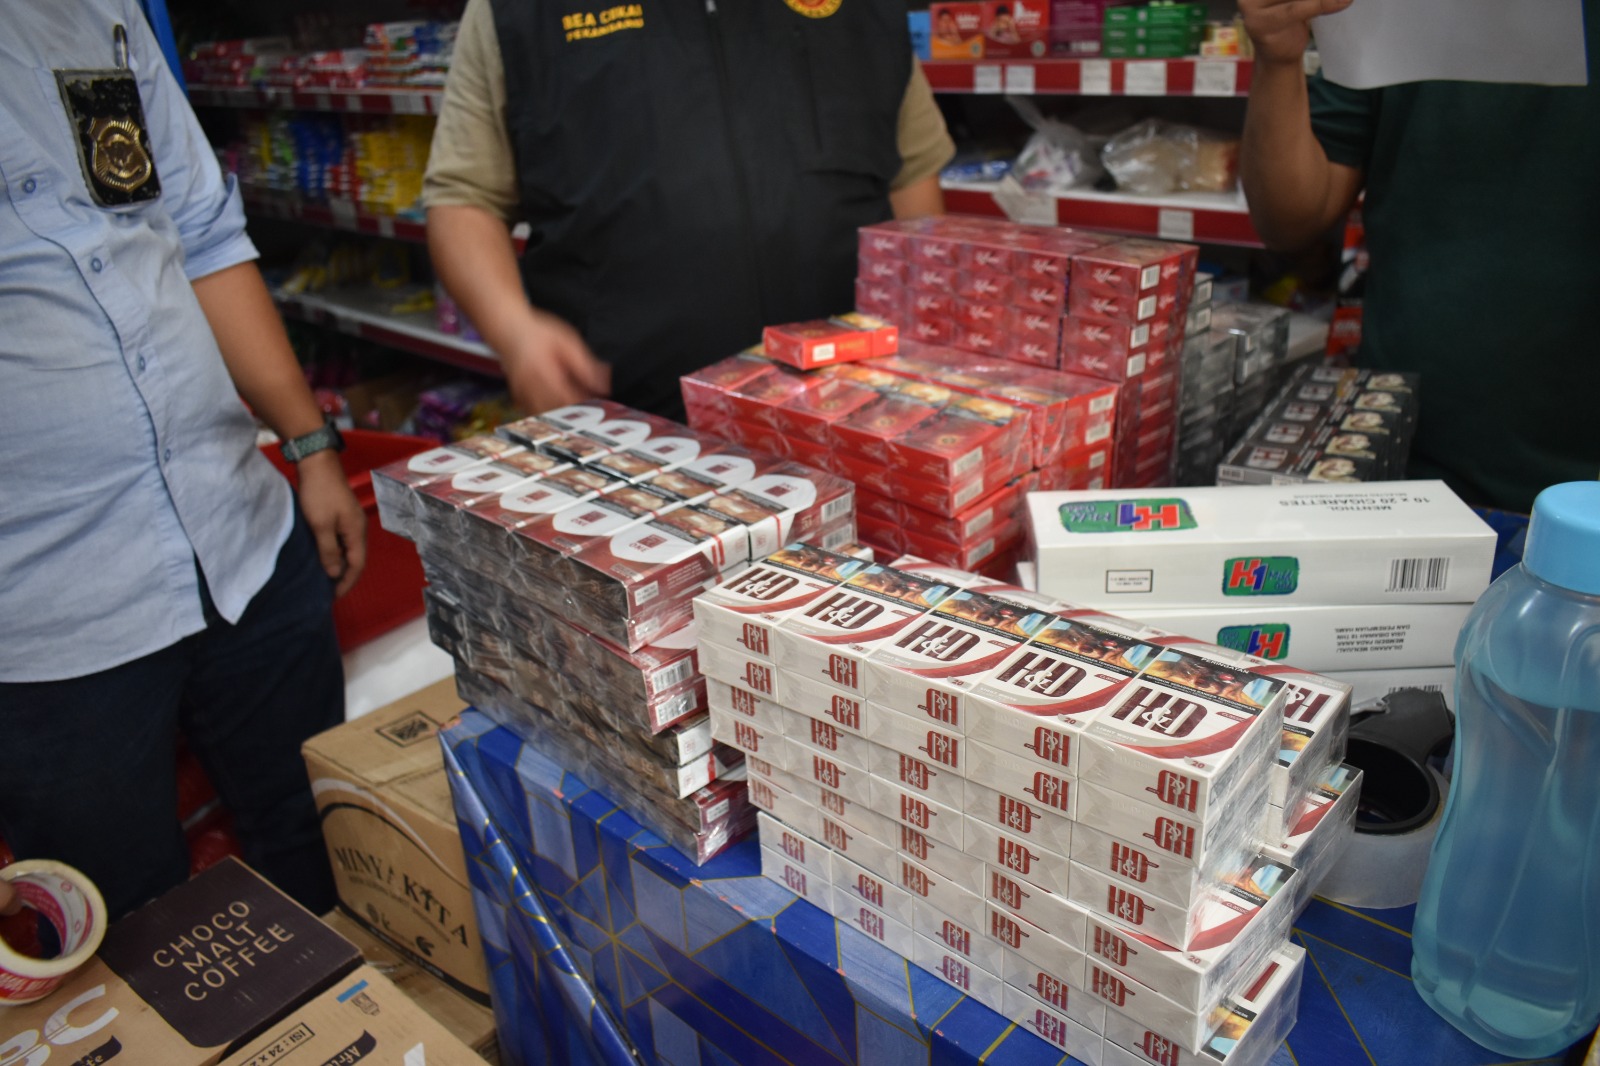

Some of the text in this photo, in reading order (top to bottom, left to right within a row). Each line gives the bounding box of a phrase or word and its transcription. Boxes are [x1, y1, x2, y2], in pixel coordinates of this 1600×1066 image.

[1117, 502, 1181, 530] H1
[1279, 498, 1376, 506] CIGARETTES
[628, 542, 648, 553] ONE
[722, 567, 800, 600] H&D
[1228, 559, 1269, 592] H1
[803, 592, 885, 629] H&D
[743, 623, 769, 656] H&D
[852, 644, 864, 652] 20
[895, 620, 980, 661] H&D
[1089, 625, 1132, 641] PERINGATAN
[1247, 628, 1285, 658] H1
[746, 661, 772, 694] H&D
[829, 653, 858, 689] H&D
[996, 651, 1087, 697] H&D
[1201, 657, 1250, 674] PERINGATAN
[831, 695, 860, 730] H&D
[926, 688, 958, 726] H&D
[1064, 717, 1077, 725] 20
[1111, 685, 1208, 738] H&D
[927, 730, 958, 768] H&D
[1034, 726, 1070, 767] H&D
[1191, 760, 1205, 769] 20
[813, 755, 840, 788] H&D
[899, 753, 929, 790] H&D
[1033, 771, 1069, 811] H&D
[1157, 769, 1199, 813] H&D
[900, 793, 929, 829] H&D
[999, 794, 1032, 833] H&D
[998, 836, 1031, 874] H&D
[1154, 816, 1195, 858] H&D
[1111, 841, 1149, 883] H&D
[1107, 884, 1145, 925] H&D
[153, 901, 250, 968] CHOCO
[182, 920, 257, 975] MALT
[1094, 925, 1128, 967] H&D
[184, 923, 295, 1001] COFFEE
[1189, 954, 1201, 964] 20
[1092, 966, 1126, 1007] H&D
[268, 1042, 285, 1058] 24
[289, 1029, 306, 1044] ISI
